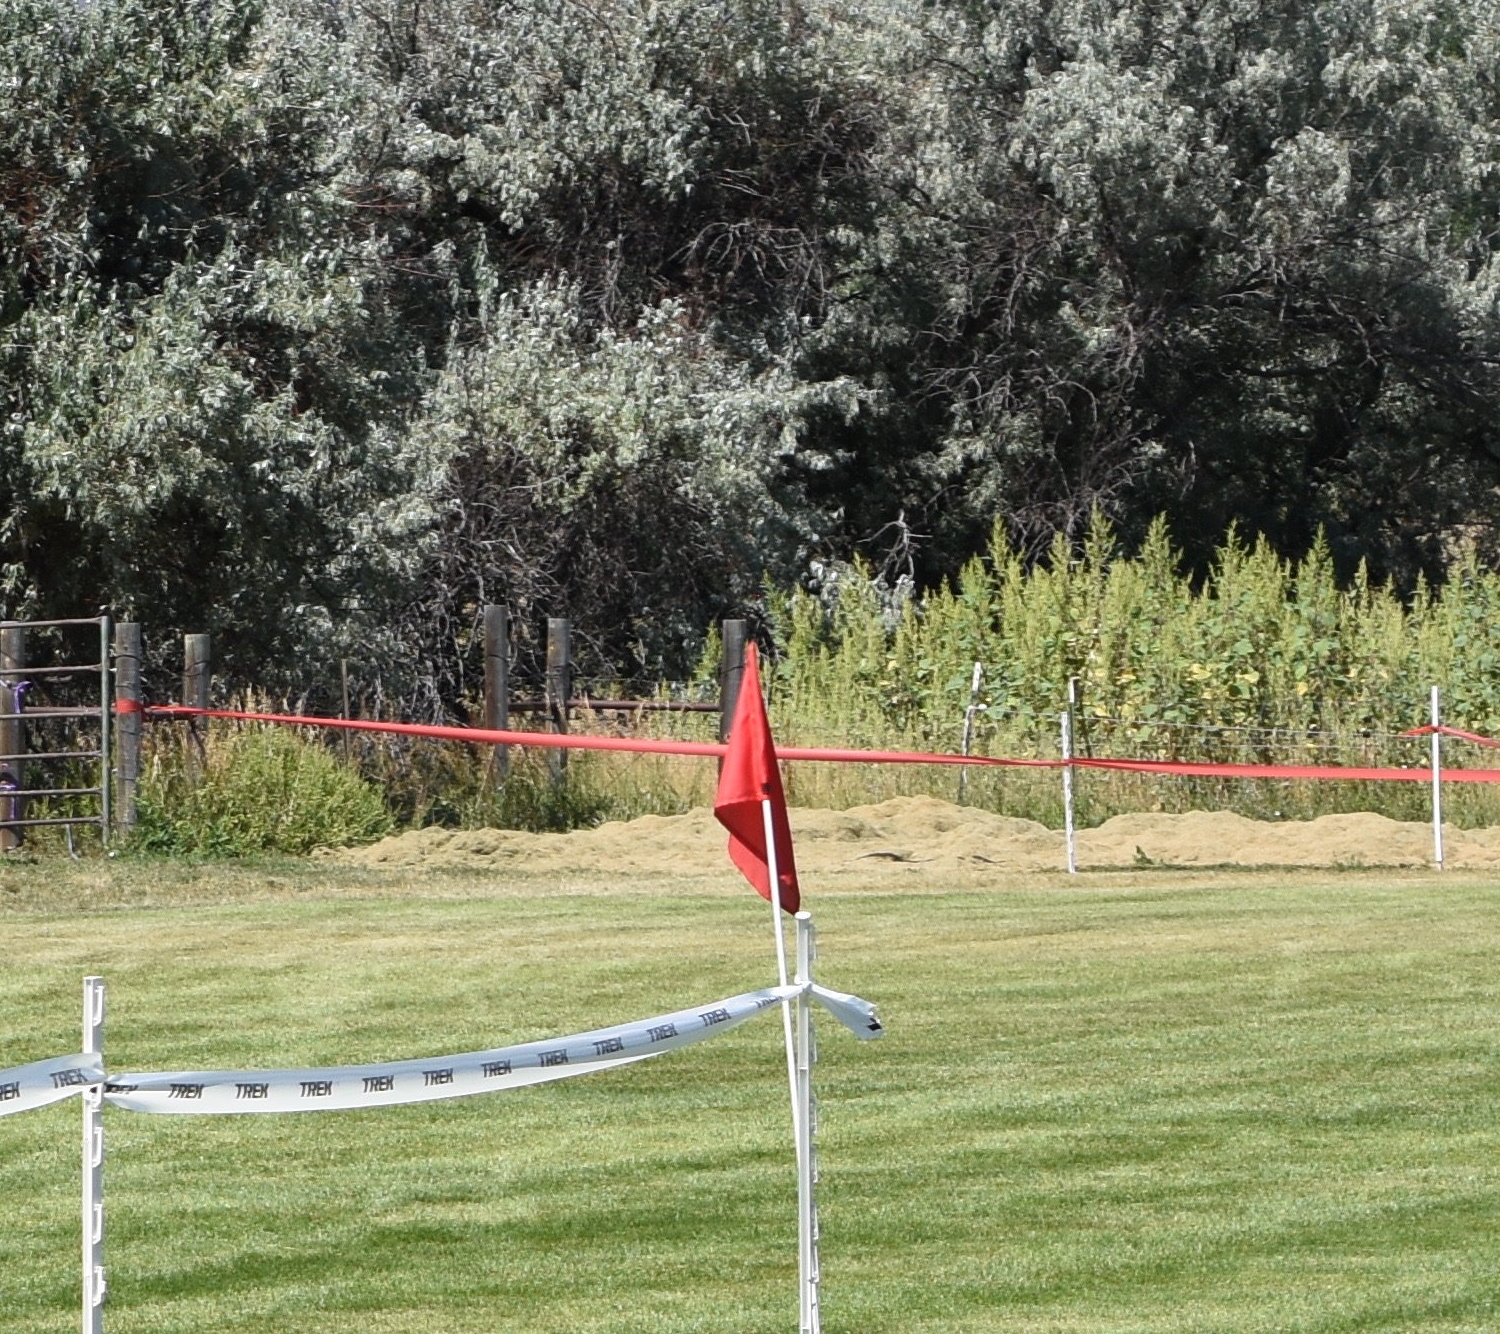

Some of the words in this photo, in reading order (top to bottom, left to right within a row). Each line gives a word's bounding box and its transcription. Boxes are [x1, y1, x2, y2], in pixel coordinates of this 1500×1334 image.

[168, 1082, 204, 1099] TREK
[234, 1082, 270, 1099] TREK
[298, 1080, 334, 1098] TREK
[361, 1072, 396, 1093] TREK
[420, 1067, 455, 1087] TREK
[481, 1059, 512, 1078] TREK
[538, 1049, 569, 1067] TREK
[592, 1037, 624, 1056] TREK
[646, 1022, 679, 1043] TREK
[698, 1007, 732, 1028] TREK
